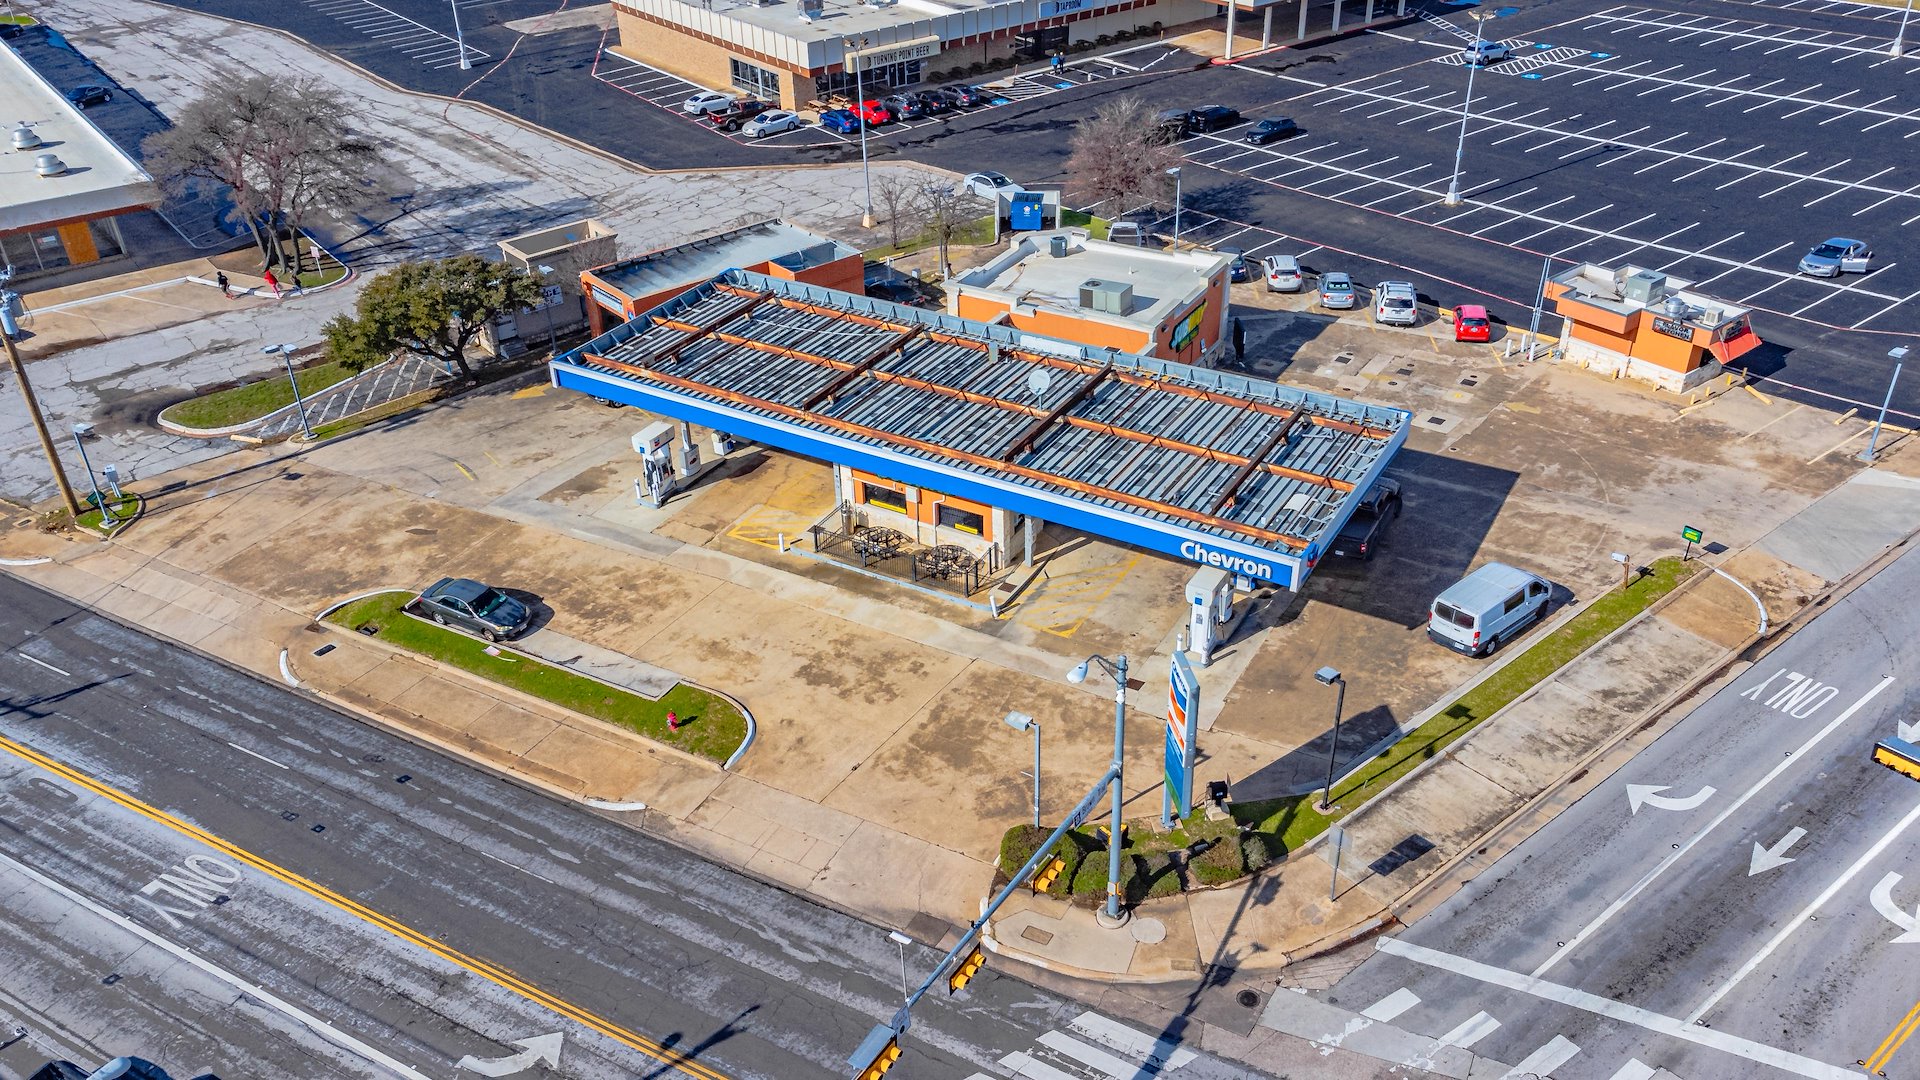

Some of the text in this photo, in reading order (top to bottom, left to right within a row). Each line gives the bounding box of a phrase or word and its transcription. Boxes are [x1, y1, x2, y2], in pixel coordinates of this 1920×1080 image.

[873, 45, 930, 65] TURNING POINT BEER
[1180, 541, 1272, 579] Chevron
[1740, 668, 1840, 719] ONLY
[131, 854, 241, 929] ONLY
